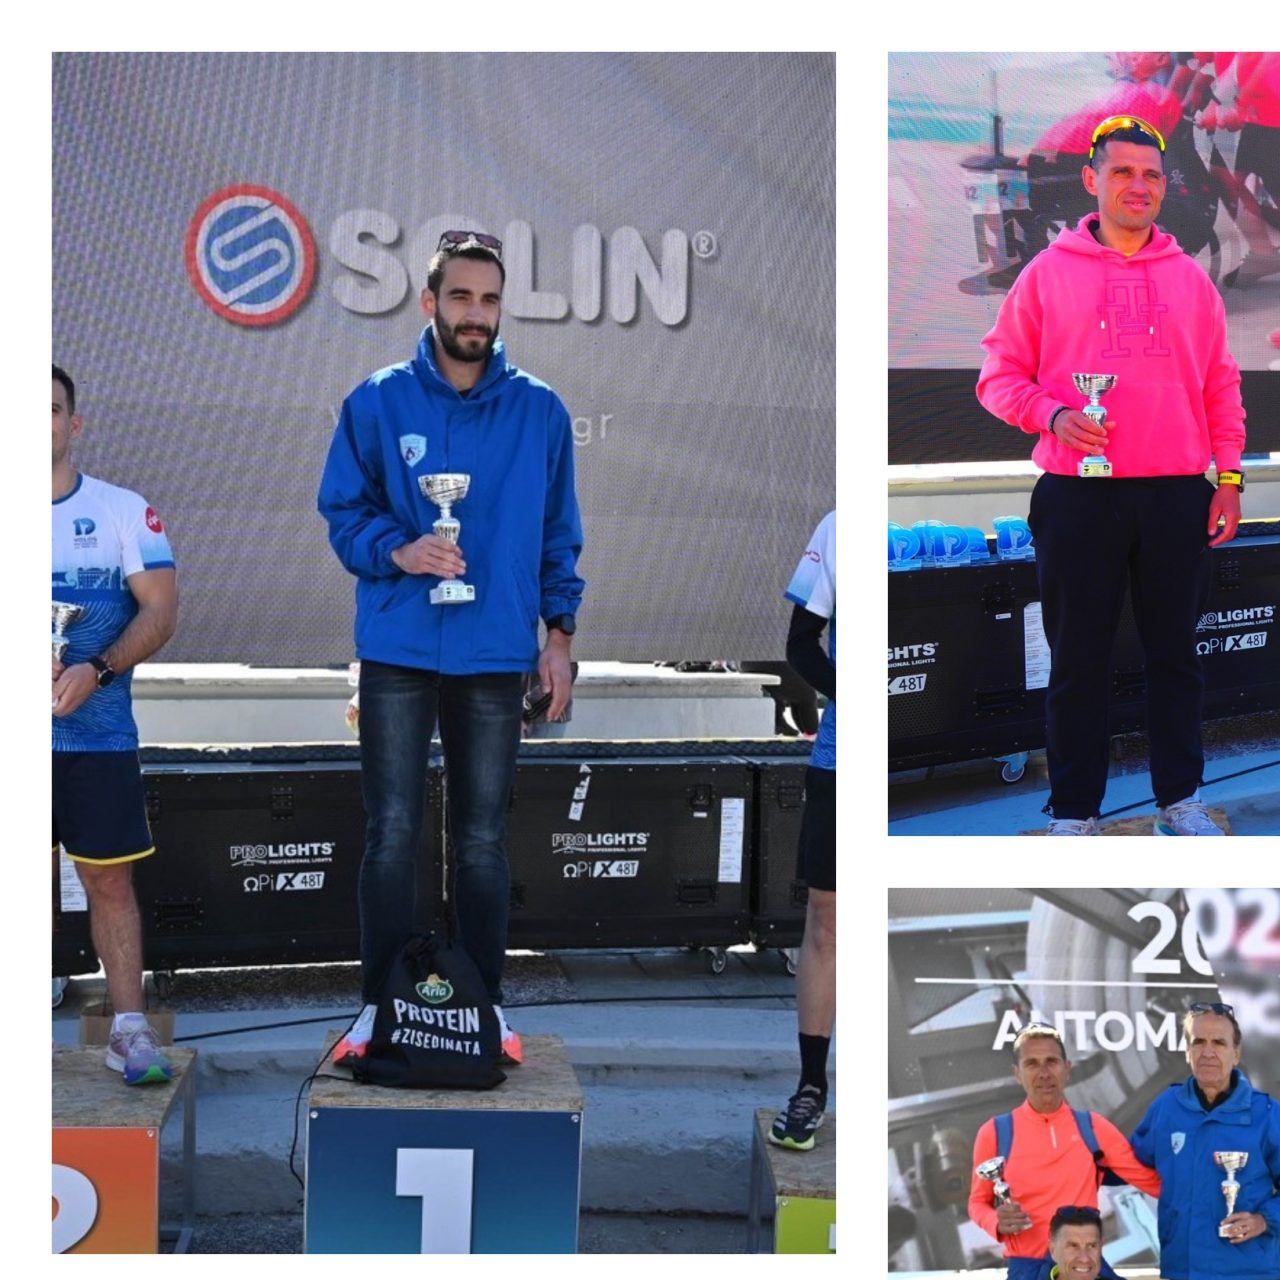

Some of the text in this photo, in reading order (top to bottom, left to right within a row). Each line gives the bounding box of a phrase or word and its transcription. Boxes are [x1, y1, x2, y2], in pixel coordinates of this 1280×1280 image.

[898, 675, 924, 692] 48T
[552, 832, 648, 847] PROLIGHTS
[230, 842, 333, 860] PROLIGHTS
[421, 985, 448, 997] Arla
[393, 998, 480, 1034] PROTEIN
